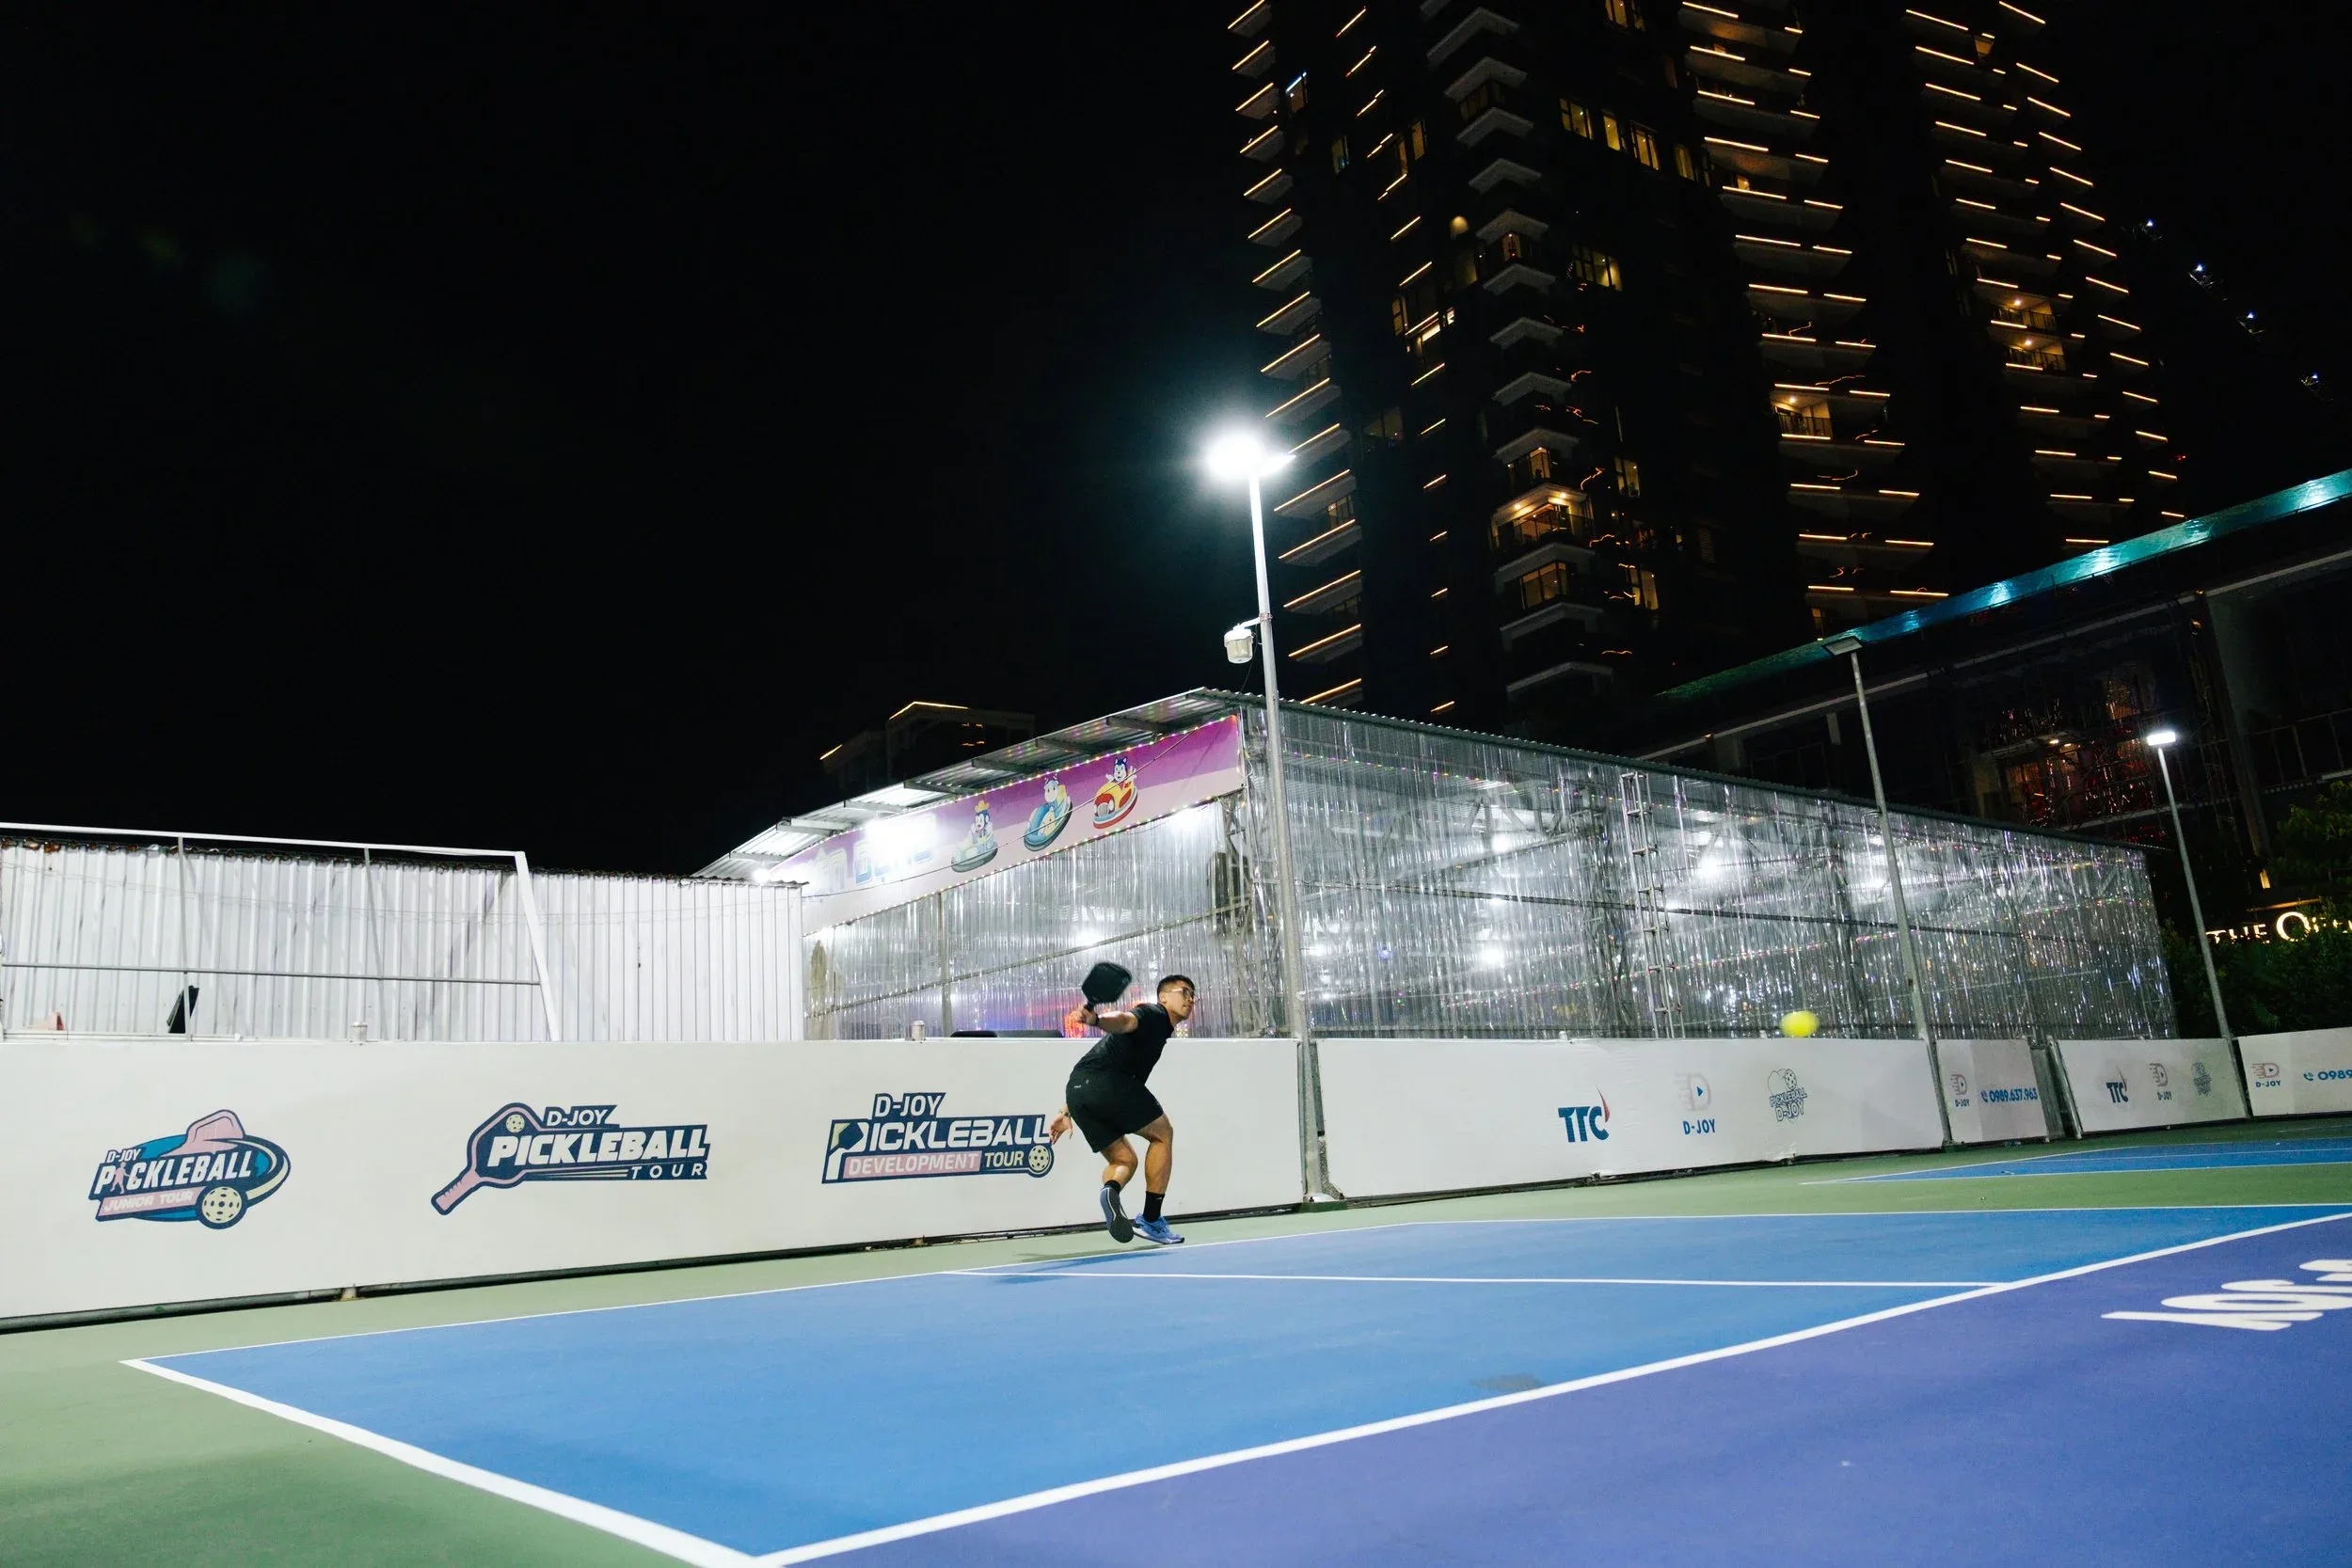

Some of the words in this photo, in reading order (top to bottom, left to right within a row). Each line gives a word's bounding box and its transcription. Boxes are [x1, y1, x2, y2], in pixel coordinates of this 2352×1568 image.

[2106, 1082, 2129, 1102] TTC
[2255, 1080, 2281, 1088] D-JOY
[874, 1095, 942, 1117] D-JOY
[1770, 1087, 1807, 1107] PICKLEBALL
[547, 1109, 608, 1127] D-JOY
[1775, 1099, 1804, 1121] D-JOY
[1558, 1105, 1610, 1143] TTC
[1682, 1119, 1716, 1135] D-JOY
[105, 1148, 141, 1164] D-JOY
[487, 1129, 707, 1167] PICKLEBALL
[825, 1117, 1051, 1180] PICKLEBALL
[631, 1163, 705, 1180] TOUR
[848, 1152, 980, 1176] DEVELOPMENT
[985, 1150, 1025, 1168] TOUR
[103, 1194, 154, 1212] JUNIOR
[159, 1190, 194, 1205] TOUR
